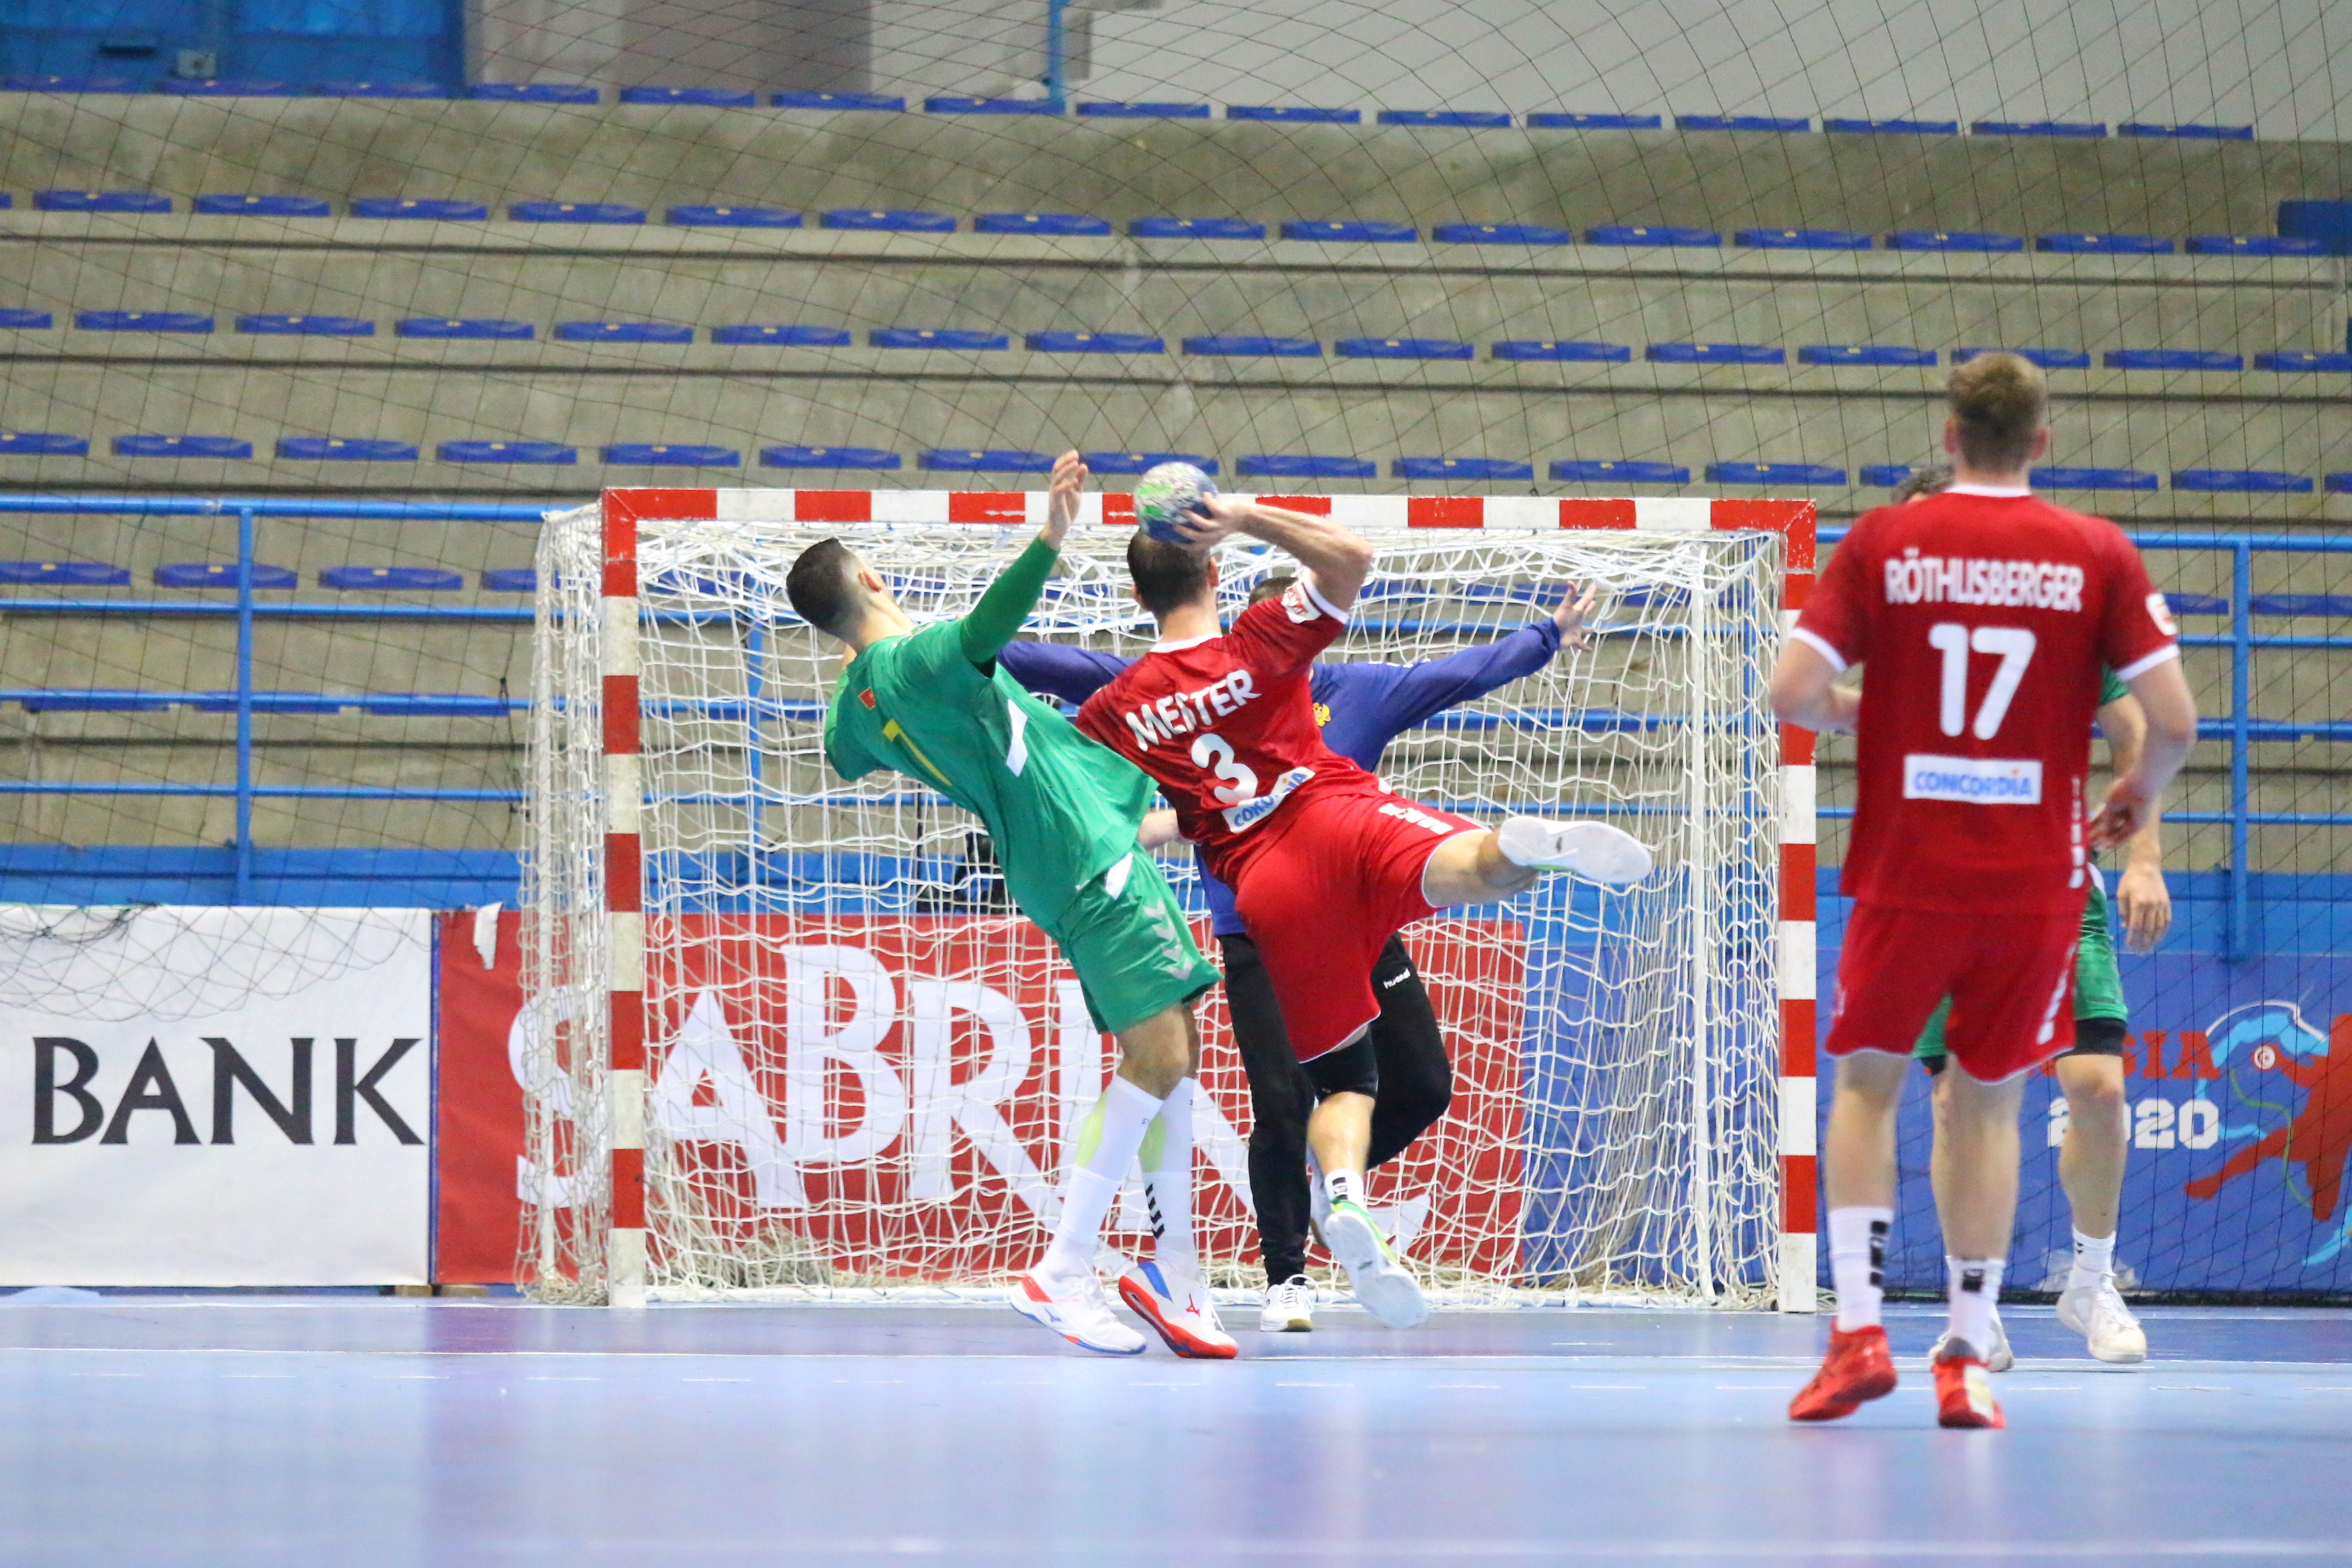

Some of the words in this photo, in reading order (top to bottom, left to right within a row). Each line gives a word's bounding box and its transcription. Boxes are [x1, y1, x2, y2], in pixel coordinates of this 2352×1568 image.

[1928, 623, 2036, 740] 17
[1191, 733, 1258, 805] 3
[32, 1035, 426, 1146] BANK
